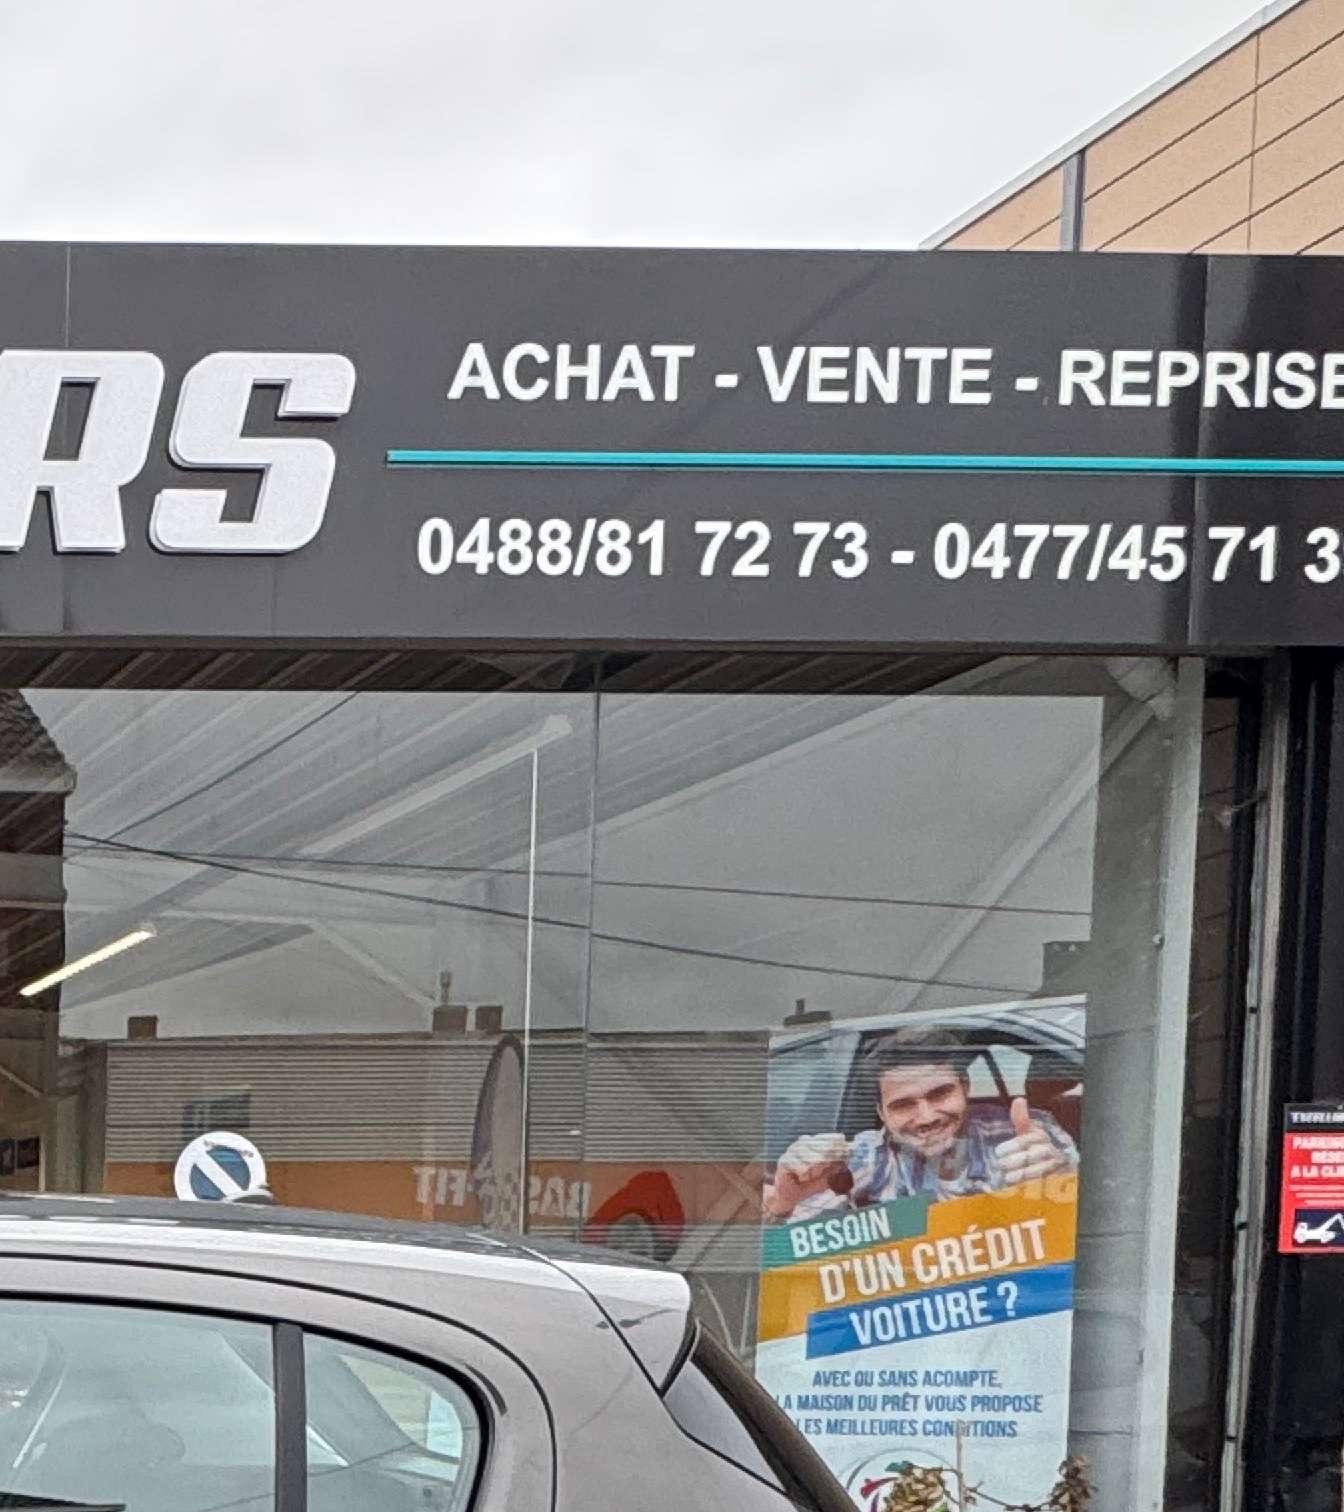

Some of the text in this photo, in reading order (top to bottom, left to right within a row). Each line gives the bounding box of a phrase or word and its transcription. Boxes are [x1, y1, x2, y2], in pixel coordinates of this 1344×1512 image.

[447, 342, 1344, 410] ACHAT - VENTE - REPRISE
[417, 517, 1344, 584] 0488/81 72 73 - 0477/45 71 3
[790, 1207, 892, 1258] BESOIN
[818, 1218, 1046, 1304] D'UN CRÉDIT
[849, 1280, 1019, 1346] VOITURE ?
[797, 1394, 854, 1411] MAISON
[858, 1394, 878, 1411] DU
[882, 1391, 921, 1412] PRÊT
[924, 1394, 968, 1412] VOUS
[971, 1394, 1044, 1413] PROPOSE
[813, 1370, 851, 1387] AVEC
[854, 1370, 875, 1387] OU
[878, 1370, 918, 1387] SANS
[826, 1418, 919, 1436] MEILLEURES
